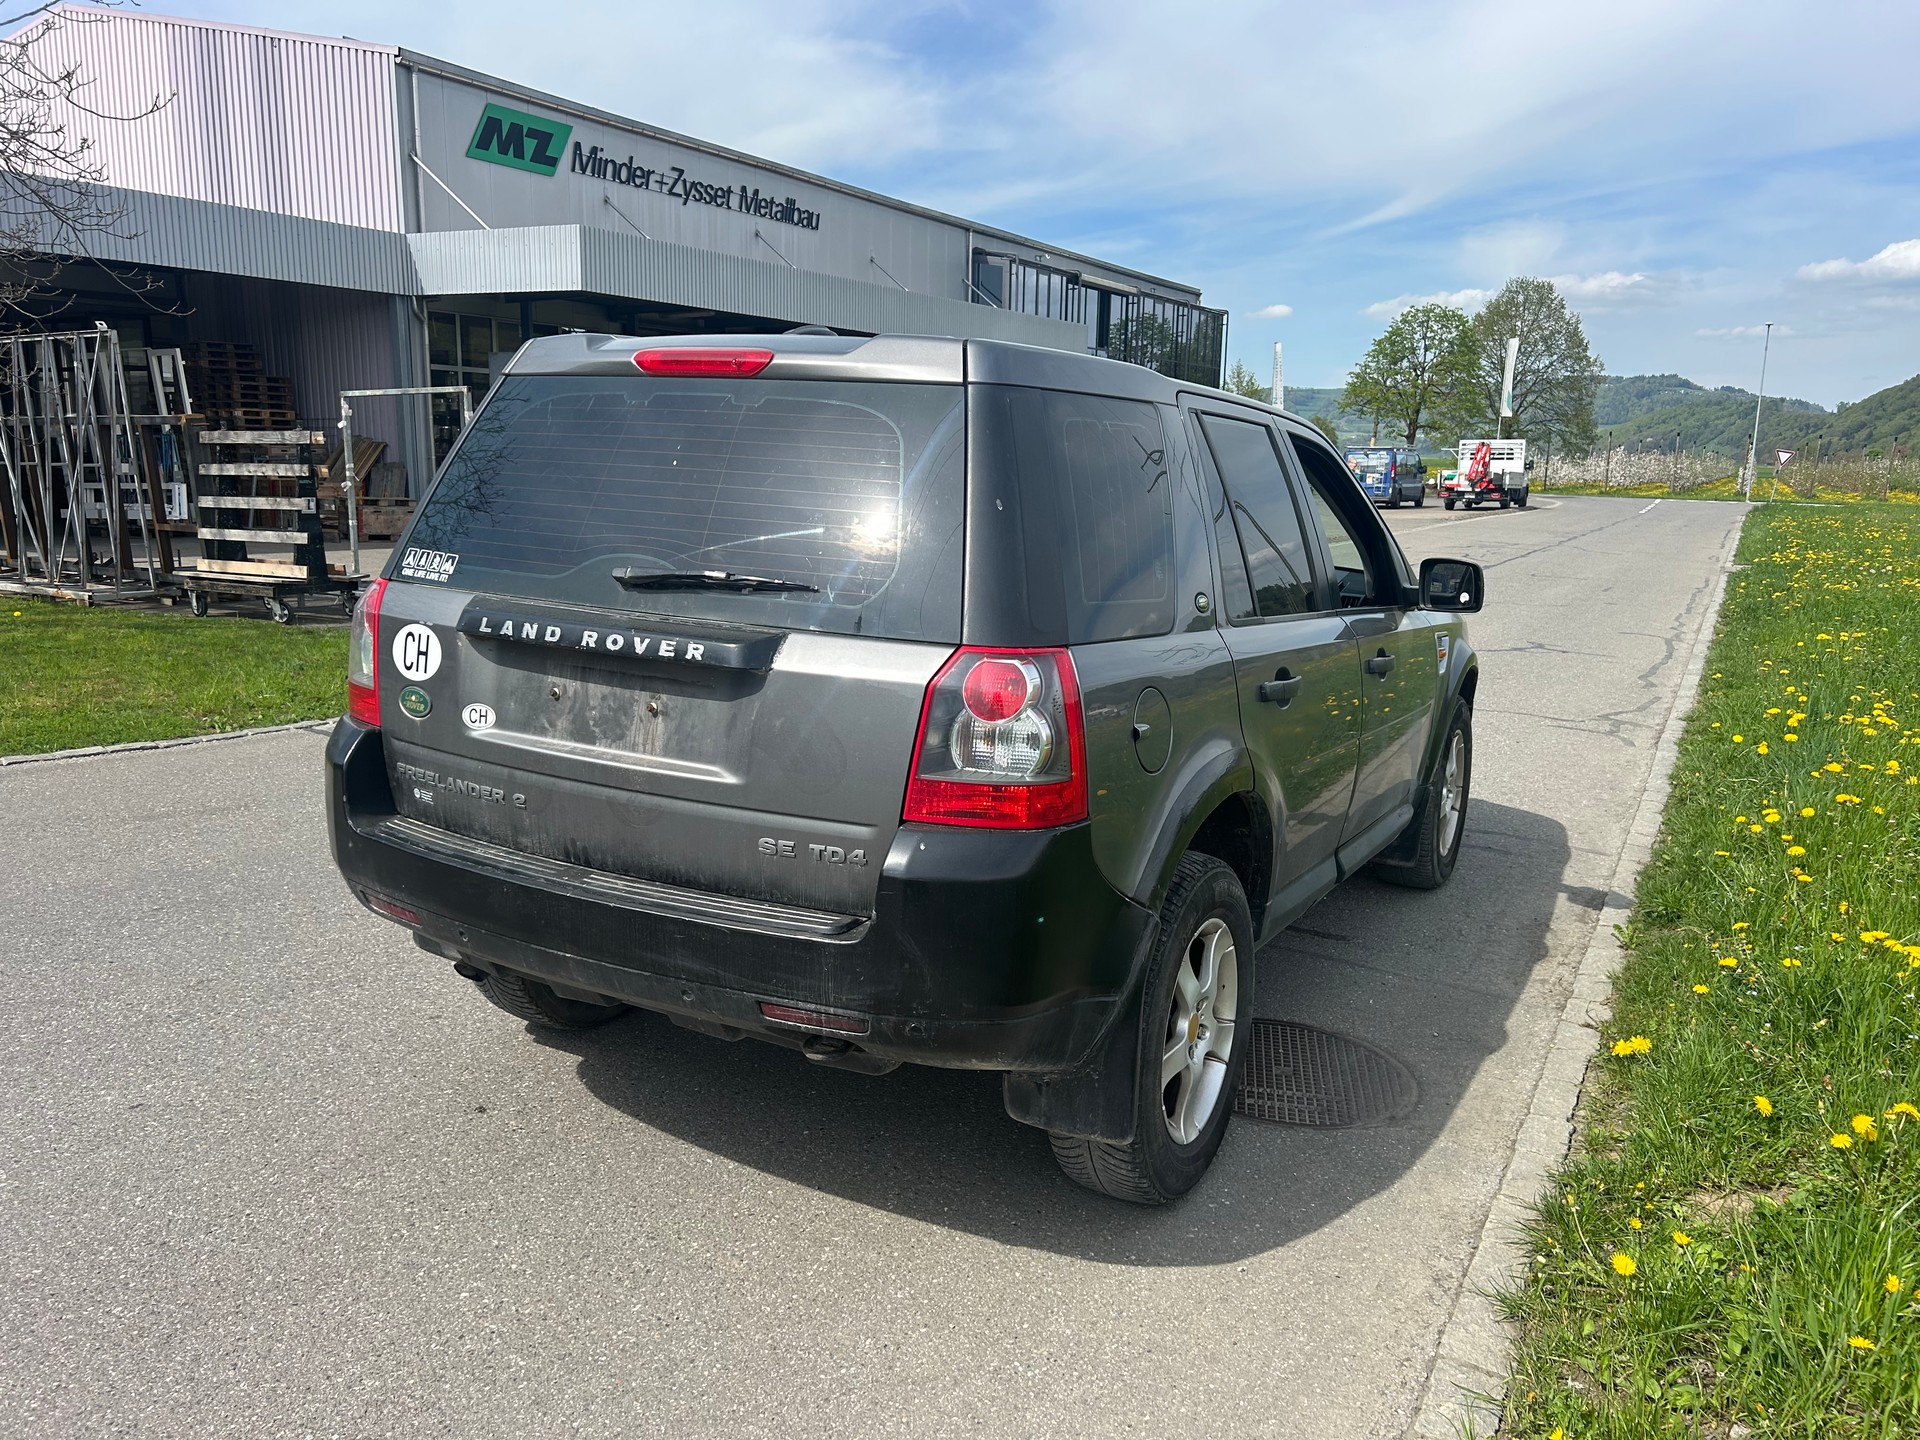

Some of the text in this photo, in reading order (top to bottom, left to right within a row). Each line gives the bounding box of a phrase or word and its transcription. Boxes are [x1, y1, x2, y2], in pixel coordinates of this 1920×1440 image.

[475, 115, 559, 168] MZ
[738, 184, 821, 231] Metallbau
[401, 567, 449, 583] ONE LIFE LIVE IT!
[403, 631, 430, 674] CH
[478, 616, 705, 661] LAND ROVER
[468, 708, 488, 725] CH
[396, 762, 506, 805] FREELANDER
[512, 793, 527, 811] 2
[758, 837, 868, 867] SE TD4
